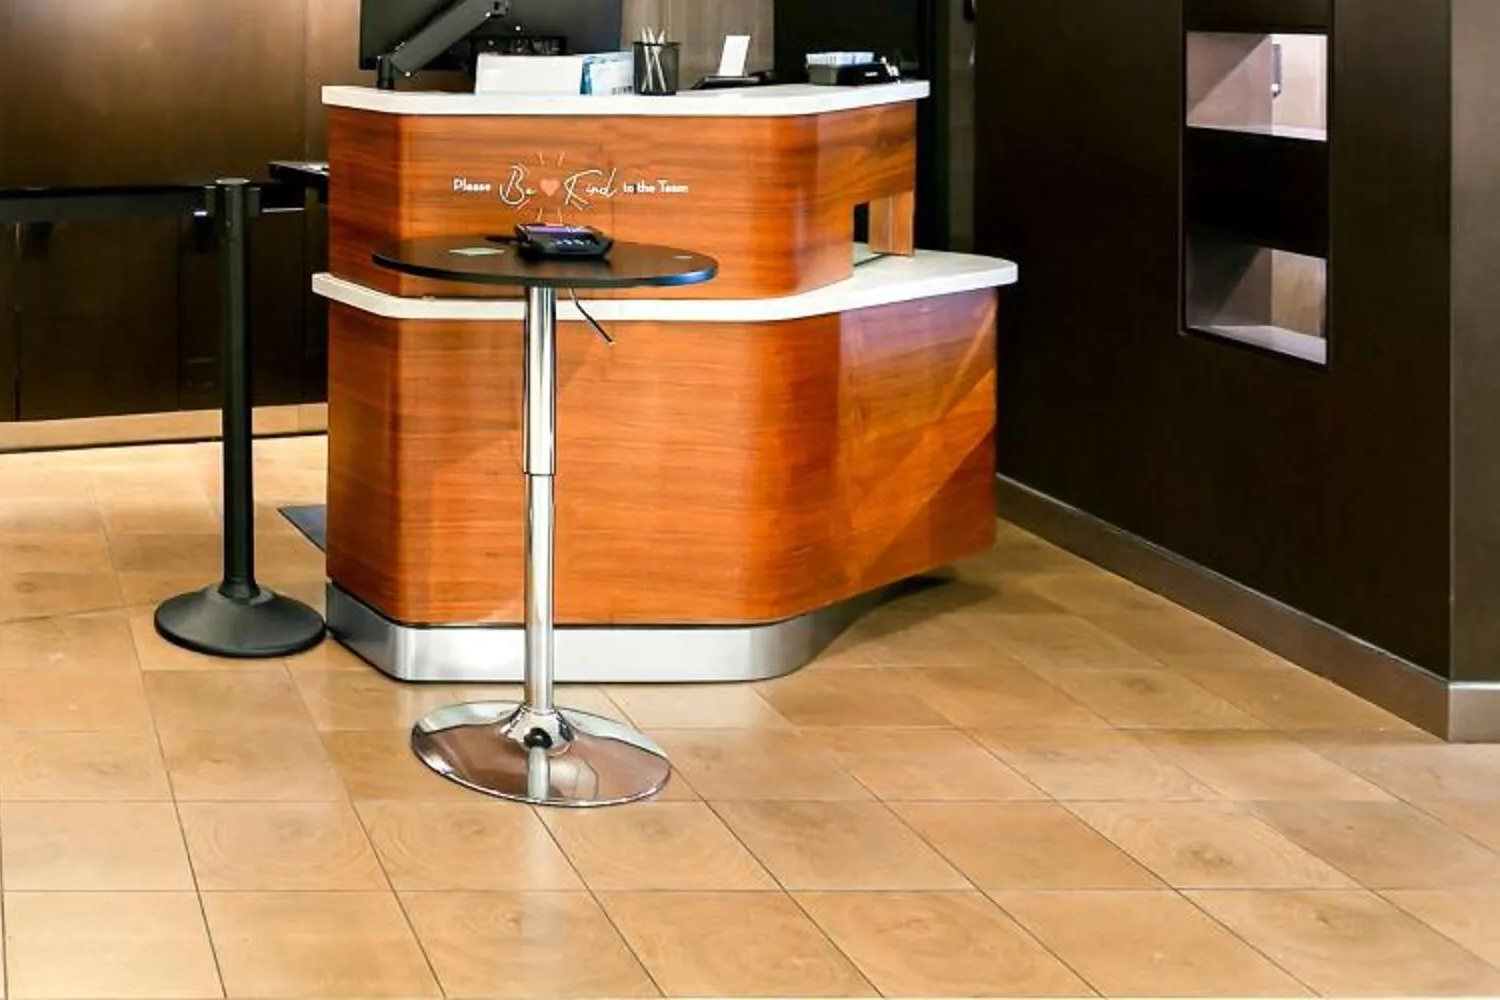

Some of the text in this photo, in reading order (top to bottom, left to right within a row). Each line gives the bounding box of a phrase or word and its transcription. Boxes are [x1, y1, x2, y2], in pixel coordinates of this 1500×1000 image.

[453, 178, 491, 193] Please
[563, 167, 617, 205] Kind
[623, 179, 634, 193] to
[636, 178, 656, 193] the
[658, 179, 689, 193] Team
